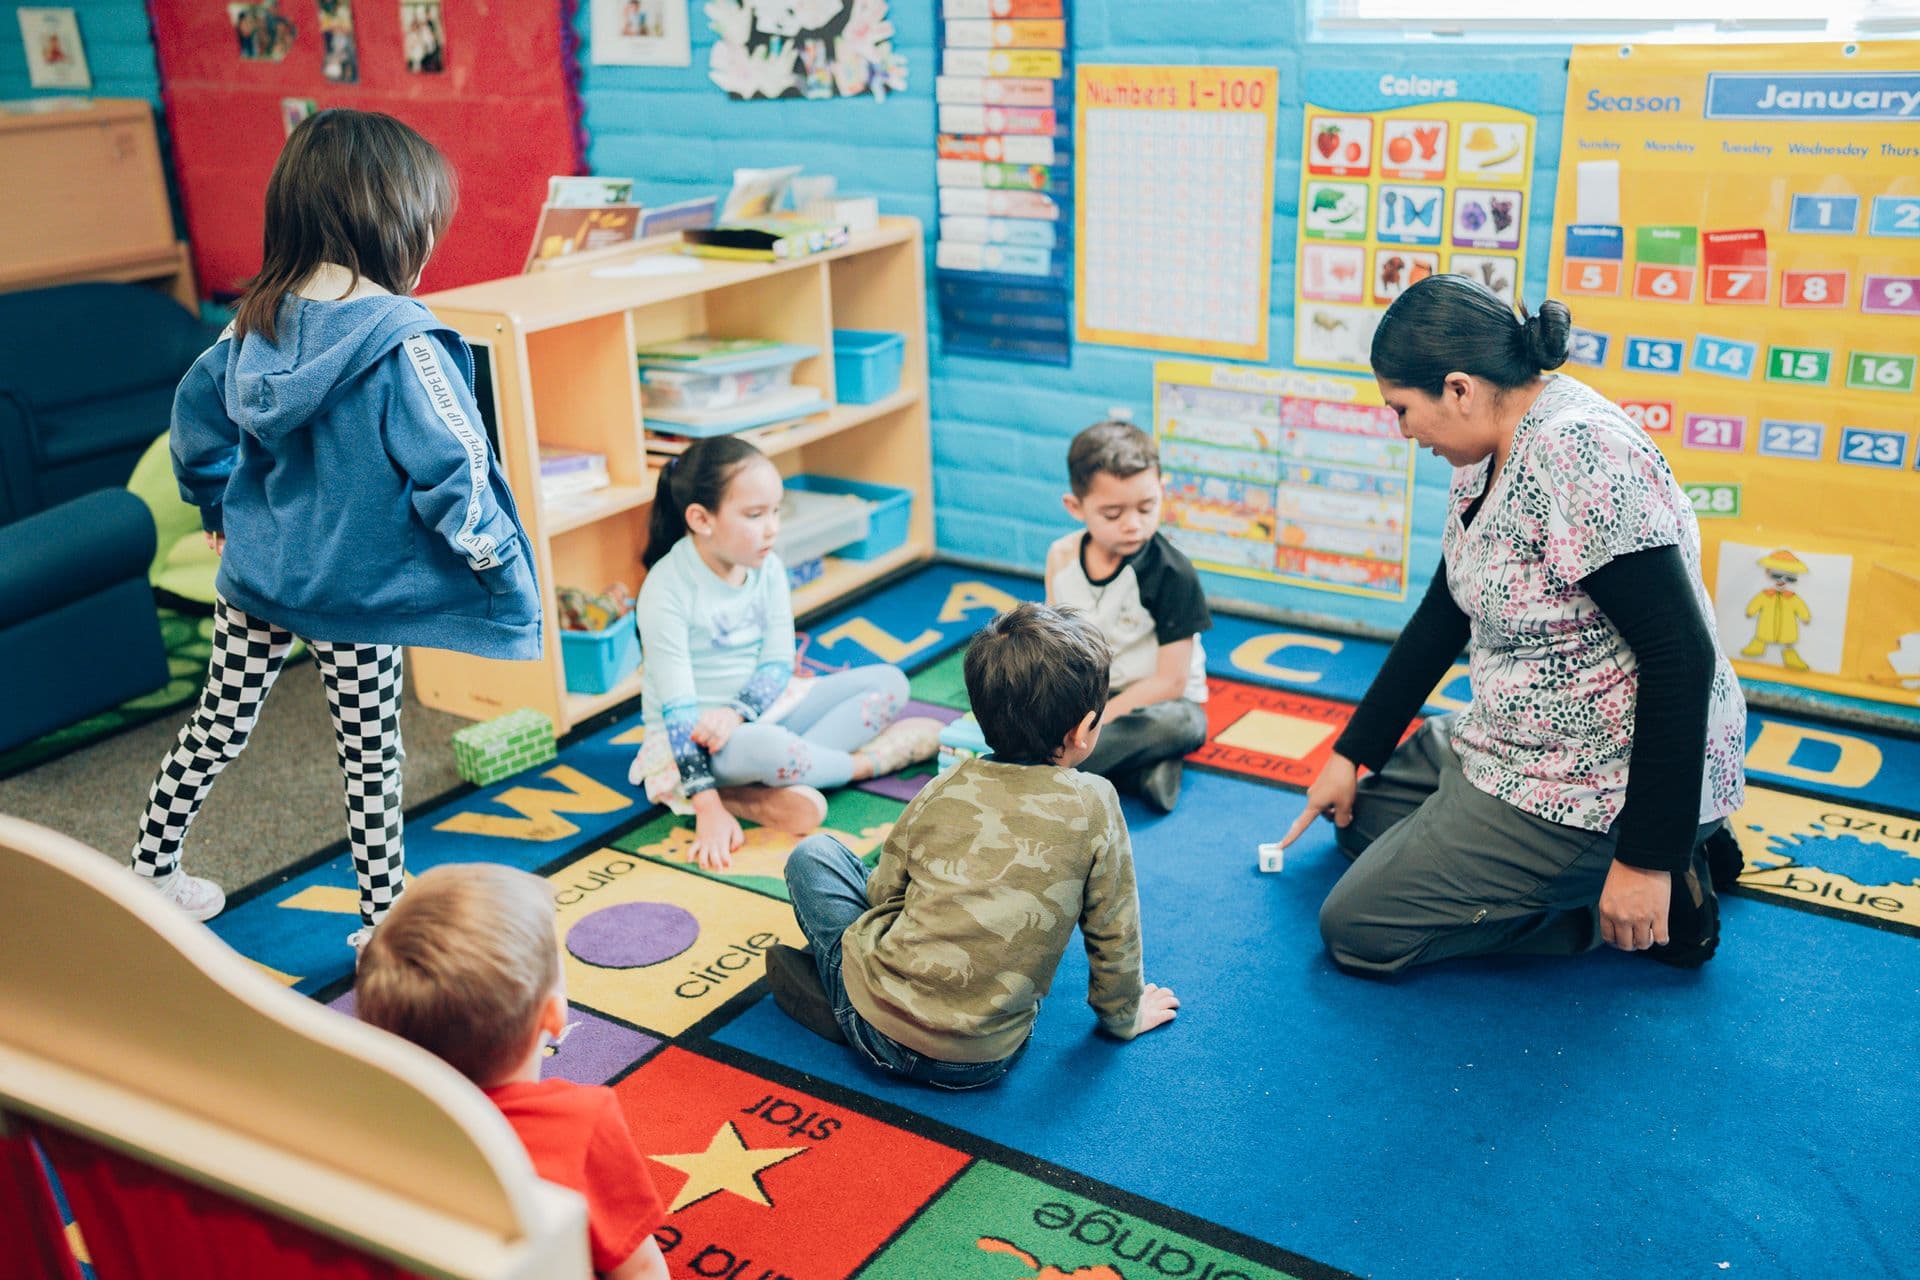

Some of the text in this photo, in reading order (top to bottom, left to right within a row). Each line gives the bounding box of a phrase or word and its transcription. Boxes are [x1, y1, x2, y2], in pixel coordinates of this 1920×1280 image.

[1086, 79, 1265, 109] Numbers 1-100
[1379, 73, 1458, 97] Colors
[1586, 88, 1681, 112] Season
[1756, 84, 1920, 115] January
[1579, 139, 1920, 158] Sunday Monday Tuesday Wednesday Thurs
[1817, 202, 1920, 228] 1 2
[1580, 266, 1913, 306] 5 6 7 8 9
[413, 346, 431, 362] UP
[1636, 342, 1674, 369] 13
[1705, 342, 1745, 371] 14
[1780, 352, 1820, 379] 15
[1862, 359, 1904, 385] 16
[421, 365, 436, 377] IT
[428, 376, 452, 409] HYPE
[447, 412, 464, 427] UP
[468, 438, 483, 469] HYPE
[1695, 420, 1733, 445] 21
[1767, 426, 1817, 452] 22
[1848, 434, 1900, 463] 23
[1690, 487, 1734, 512] 28
[1230, 633, 1344, 683] C
[1744, 720, 1883, 789] D
[432, 764, 634, 842] W
[555, 859, 636, 911] culo
[1783, 873, 1904, 912] blue
[676, 932, 780, 999] circle
[742, 1094, 842, 1141] star
